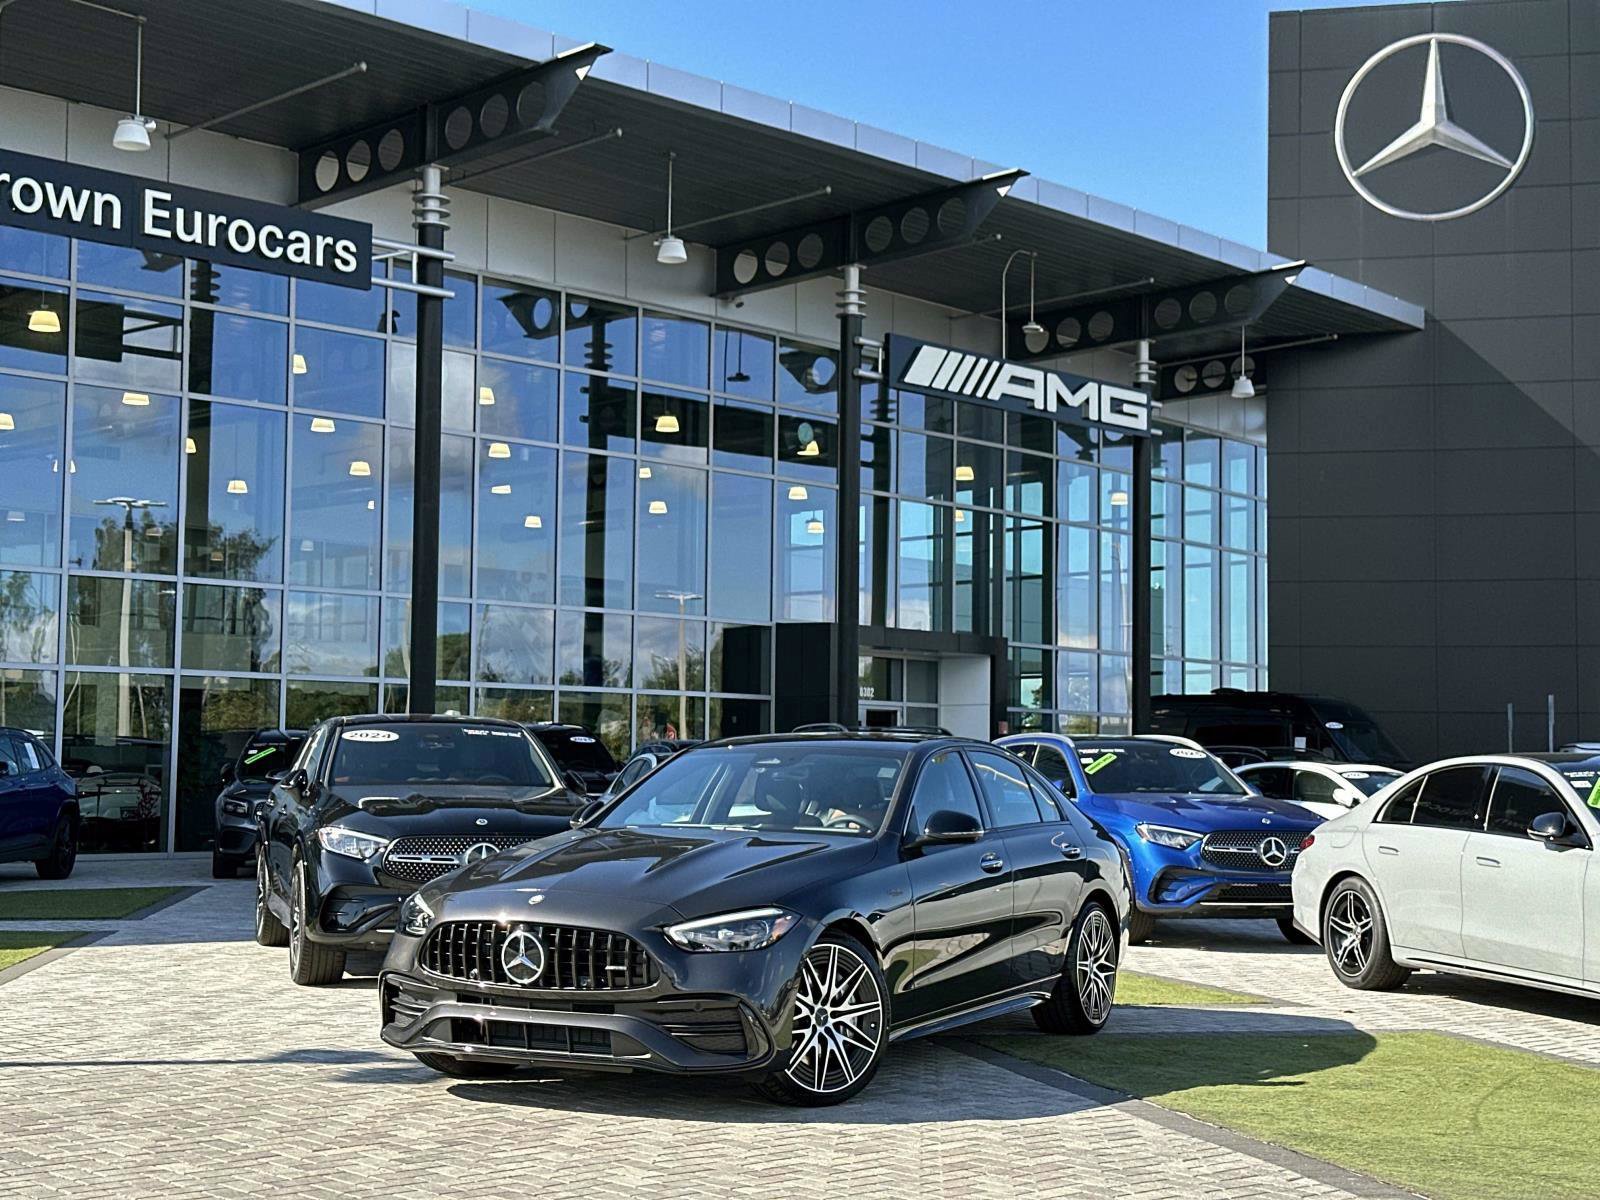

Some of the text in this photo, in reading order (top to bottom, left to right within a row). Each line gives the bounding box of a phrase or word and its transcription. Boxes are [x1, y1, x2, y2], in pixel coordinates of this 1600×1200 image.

[143, 188, 358, 273] Eurocars
[986, 362, 1148, 431] AMG
[348, 731, 392, 740] 2024
